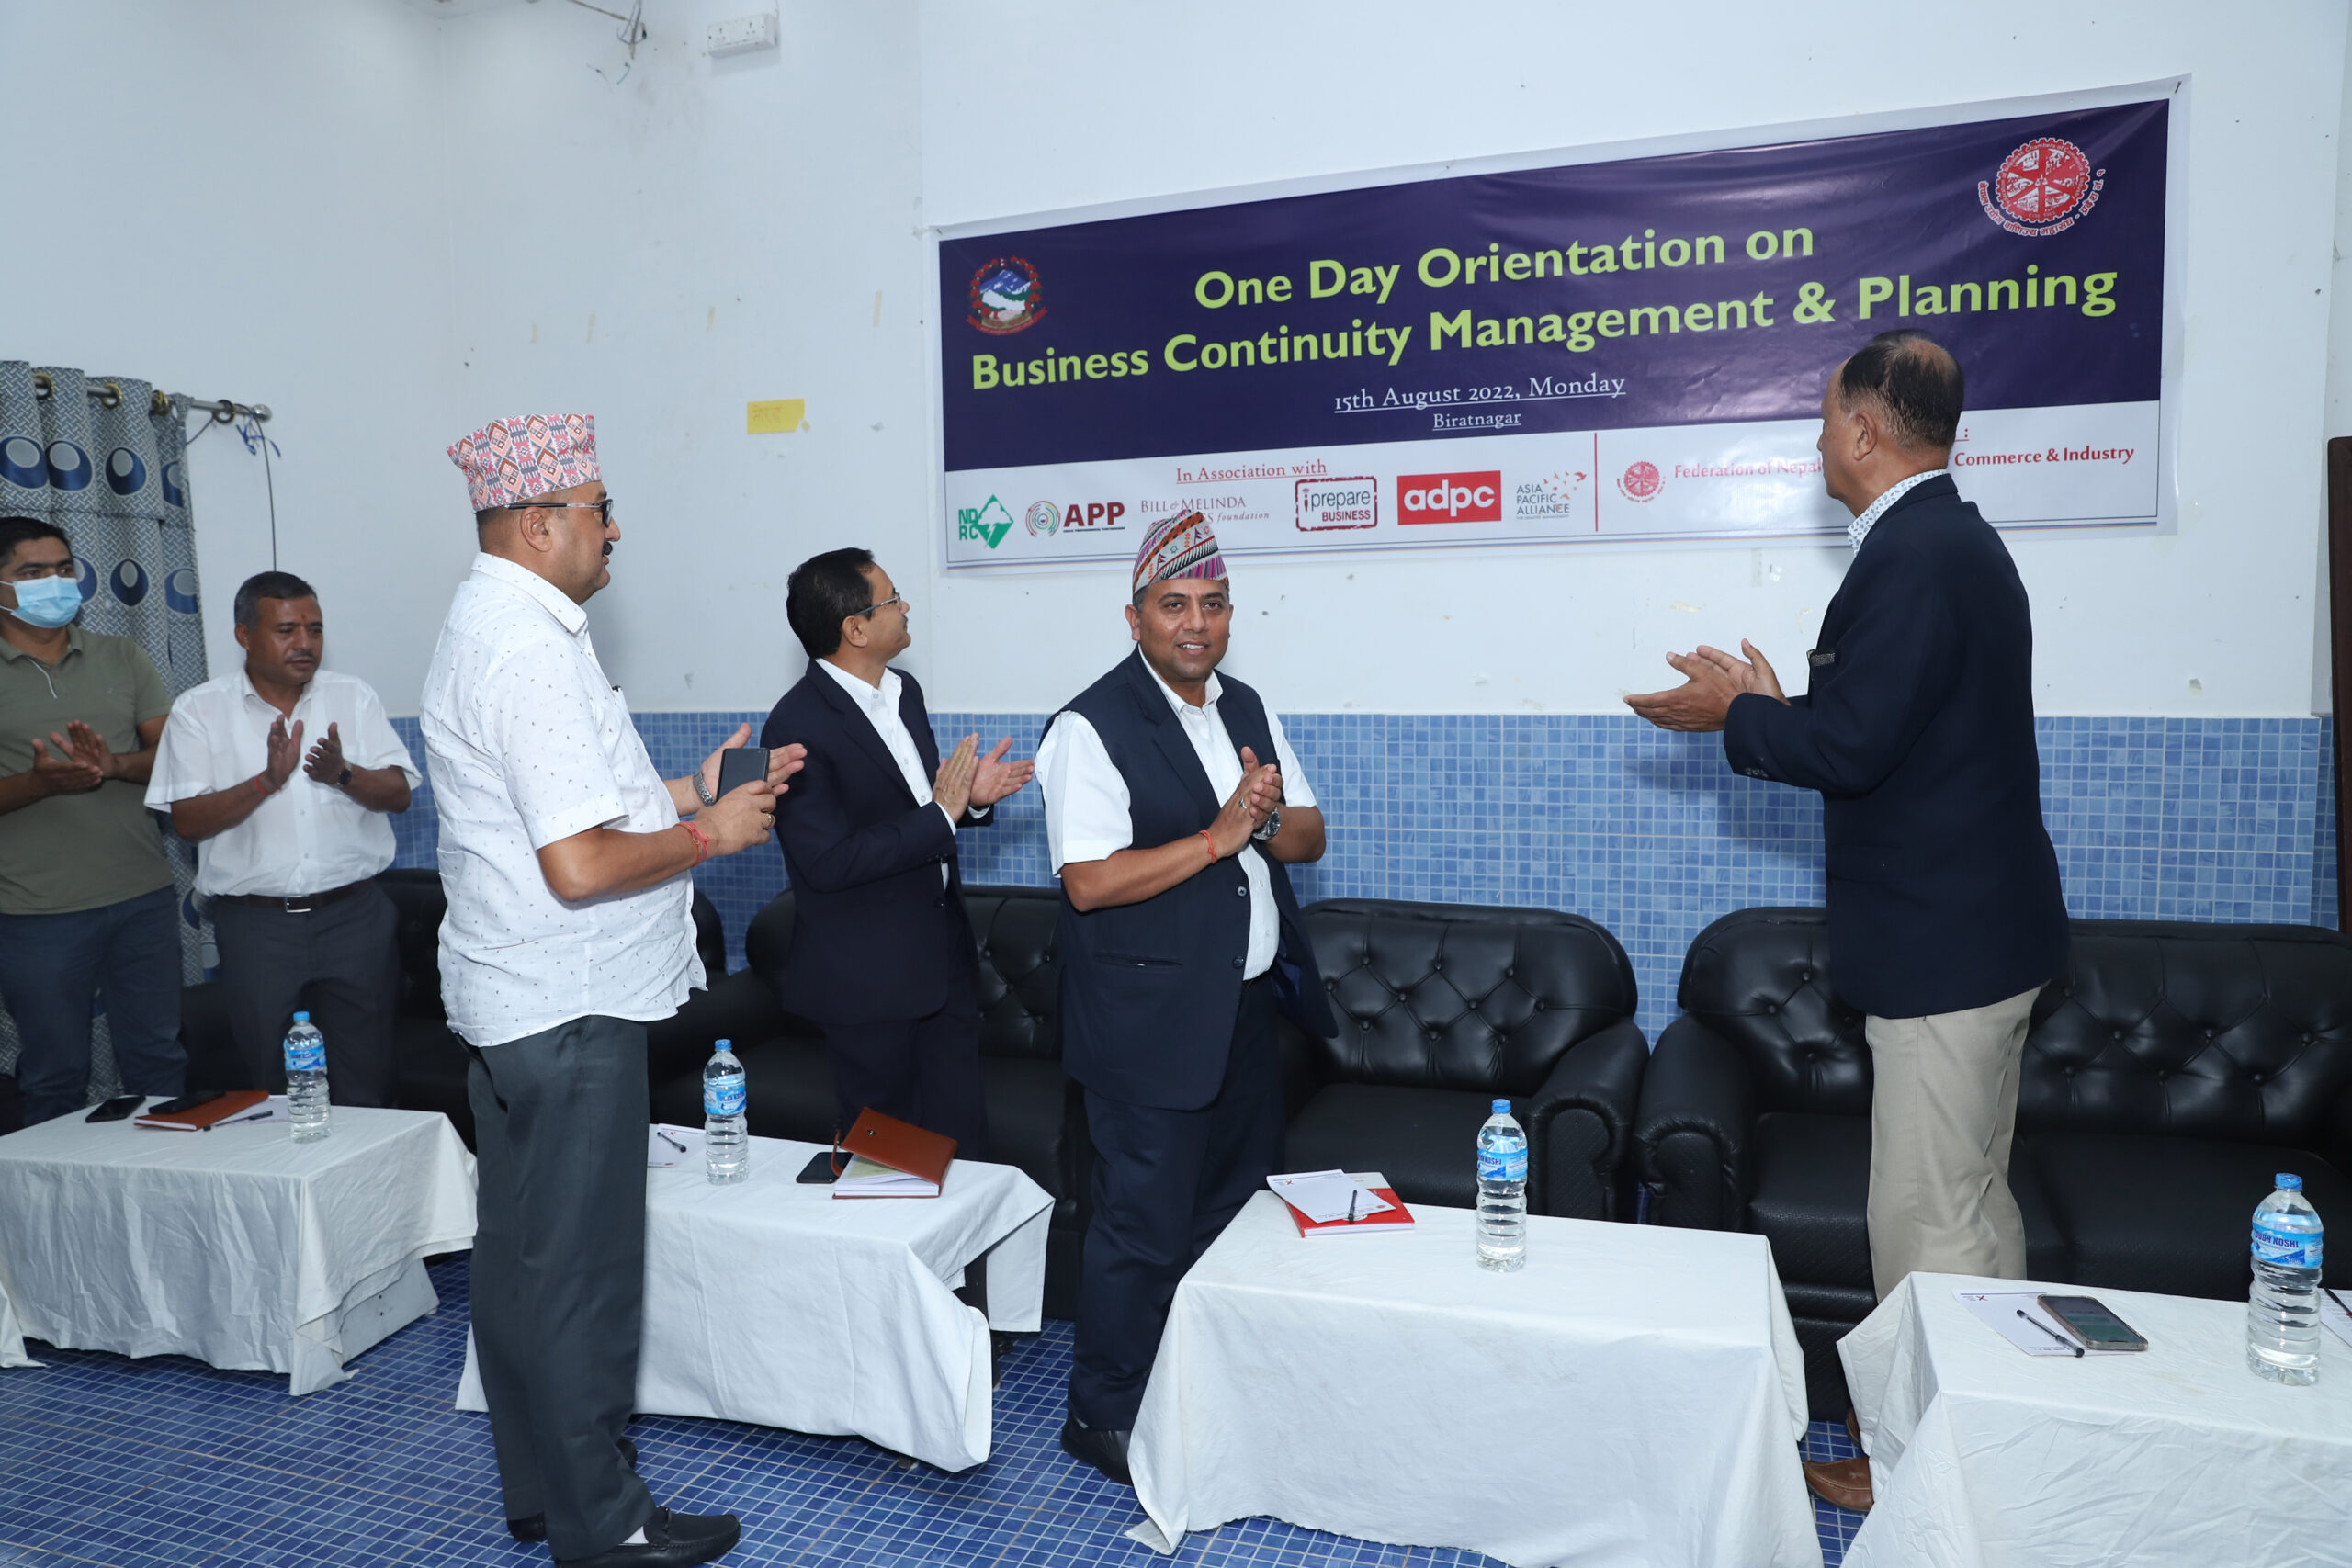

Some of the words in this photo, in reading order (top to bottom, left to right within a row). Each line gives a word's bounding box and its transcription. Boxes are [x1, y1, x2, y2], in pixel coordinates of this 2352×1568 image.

[1195, 270, 1293, 309] One
[1309, 259, 1401, 304] Day
[1417, 228, 1725, 288] Orientation
[1746, 227, 1814, 261] on
[972, 346, 1149, 390] Business
[1164, 319, 1412, 366] Continuity
[1430, 290, 1774, 353] Management
[1792, 282, 1836, 323] &
[1859, 264, 2118, 320] Planning
[1335, 388, 1374, 412] 15th
[1382, 386, 1461, 411] August
[1468, 384, 1521, 401] 2022,
[1529, 372, 1626, 398] Monday
[1433, 412, 1521, 430] Biratnagar
[1177, 468, 1193, 481] In
[1197, 463, 1286, 481] Association
[1291, 458, 1328, 475] with
[1674, 461, 1754, 479] Federation
[1757, 459, 1772, 475] of
[1954, 449, 2042, 467] Commerce
[2046, 447, 2060, 462] &
[2064, 446, 2135, 465] Industry
[1516, 484, 1544, 494] ASIA
[1141, 499, 1170, 513] BILL
[1181, 496, 1246, 511] MELINDA
[1403, 479, 1496, 517] adpc
[1516, 493, 1557, 504] PACIFIC
[958, 508, 978, 525] ND
[1063, 502, 1125, 527] APP
[1217, 511, 1270, 524] foundation
[1322, 510, 1371, 522] BUSINESS
[1516, 503, 1570, 515] ALLIANCE
[958, 525, 978, 541] RC
[2273, 1237, 2299, 1248] KOSHI
